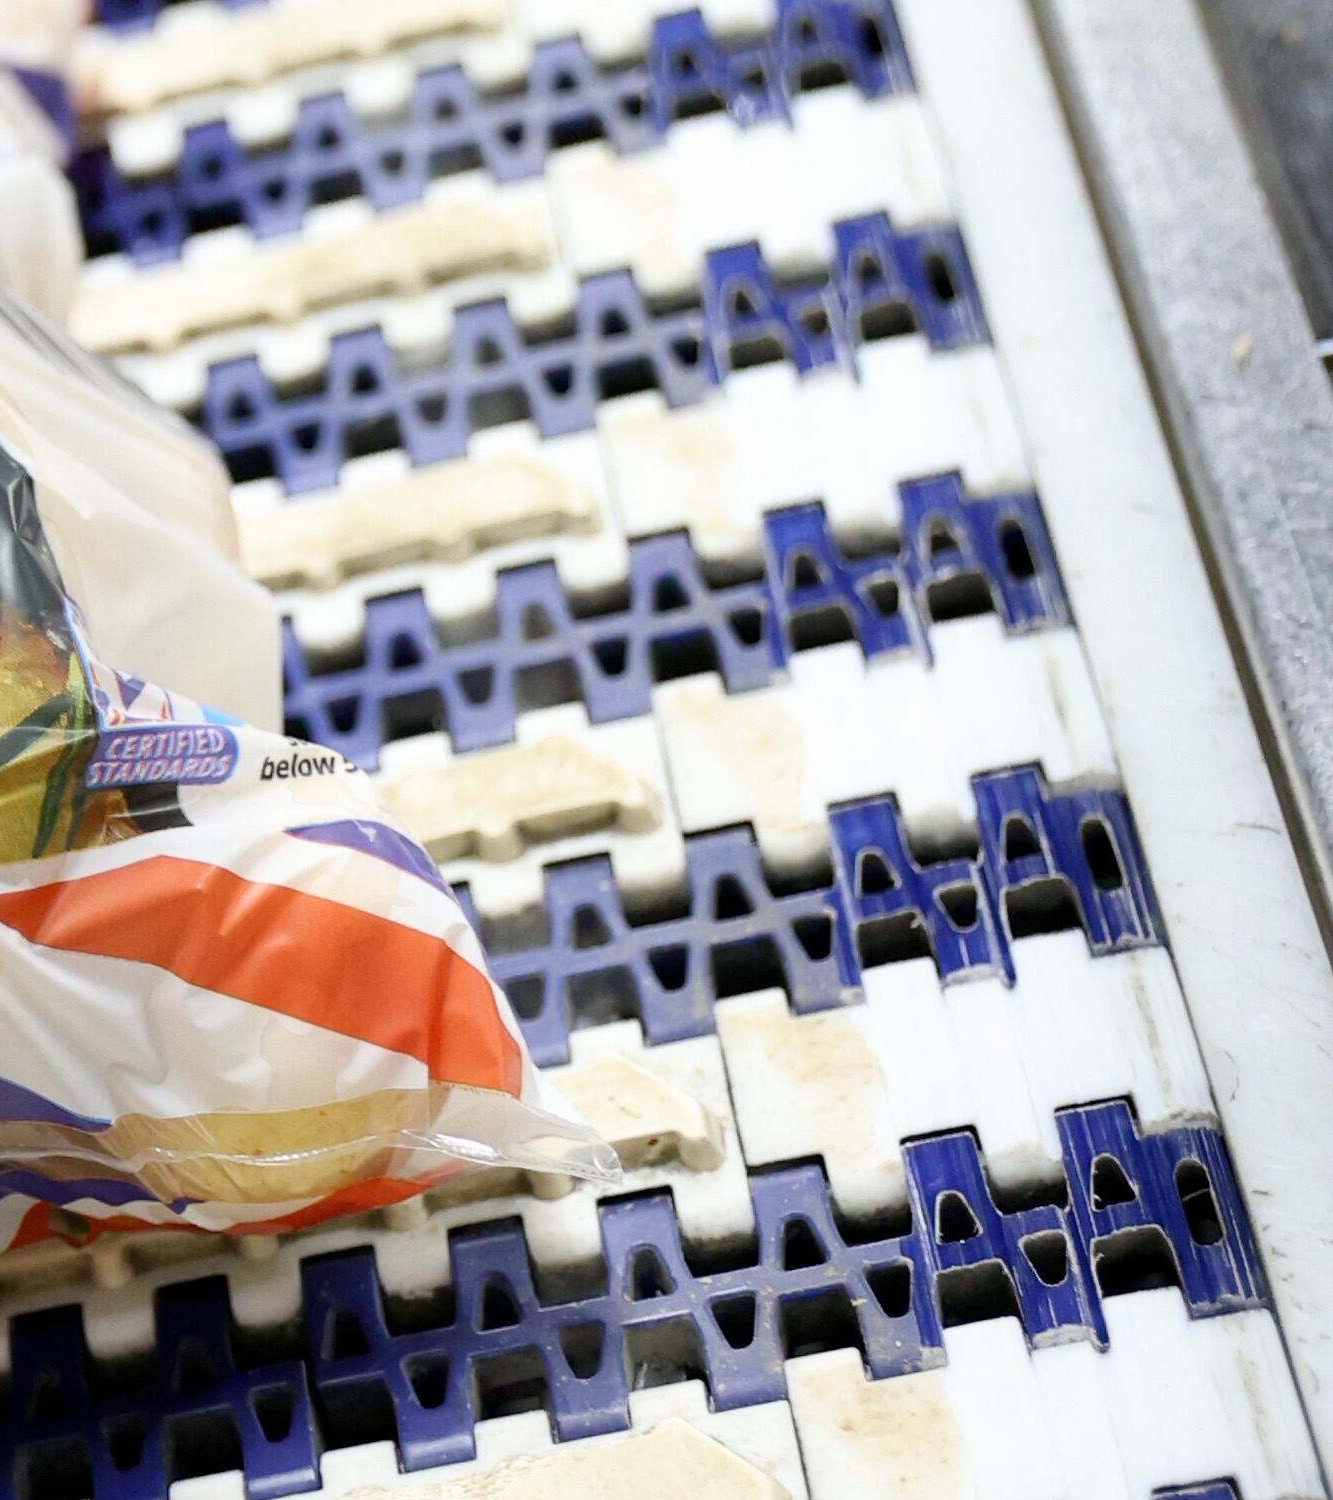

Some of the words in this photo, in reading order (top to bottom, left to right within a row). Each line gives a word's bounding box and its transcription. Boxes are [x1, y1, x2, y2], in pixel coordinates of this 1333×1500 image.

[106, 727, 226, 759] CERTIFIED
[87, 753, 231, 787] STANDARDS
[260, 752, 336, 781] below
